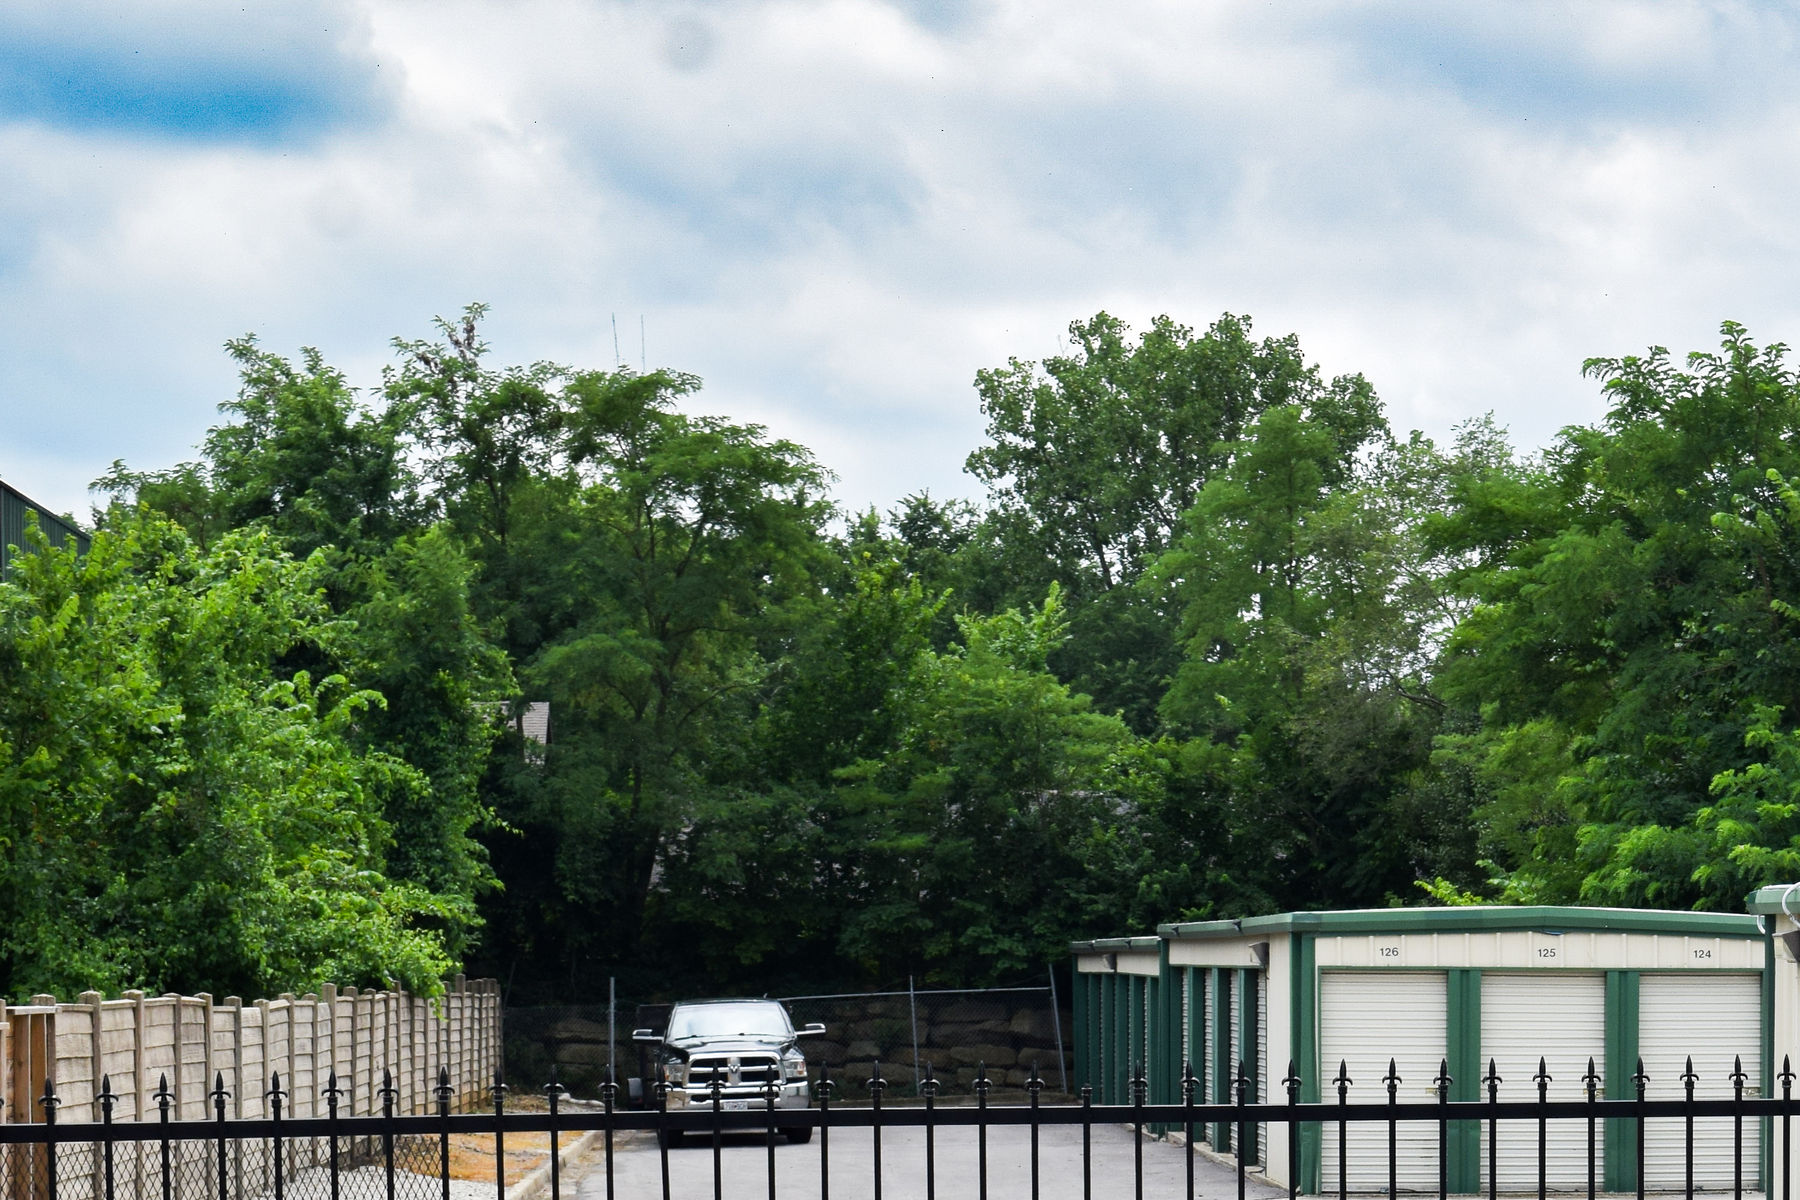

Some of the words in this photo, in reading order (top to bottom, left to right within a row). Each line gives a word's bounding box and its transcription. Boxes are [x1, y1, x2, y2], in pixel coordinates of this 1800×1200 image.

[1380, 947, 1399, 956] 126
[1538, 948, 1556, 957] 125
[1694, 949, 1711, 958] 124
